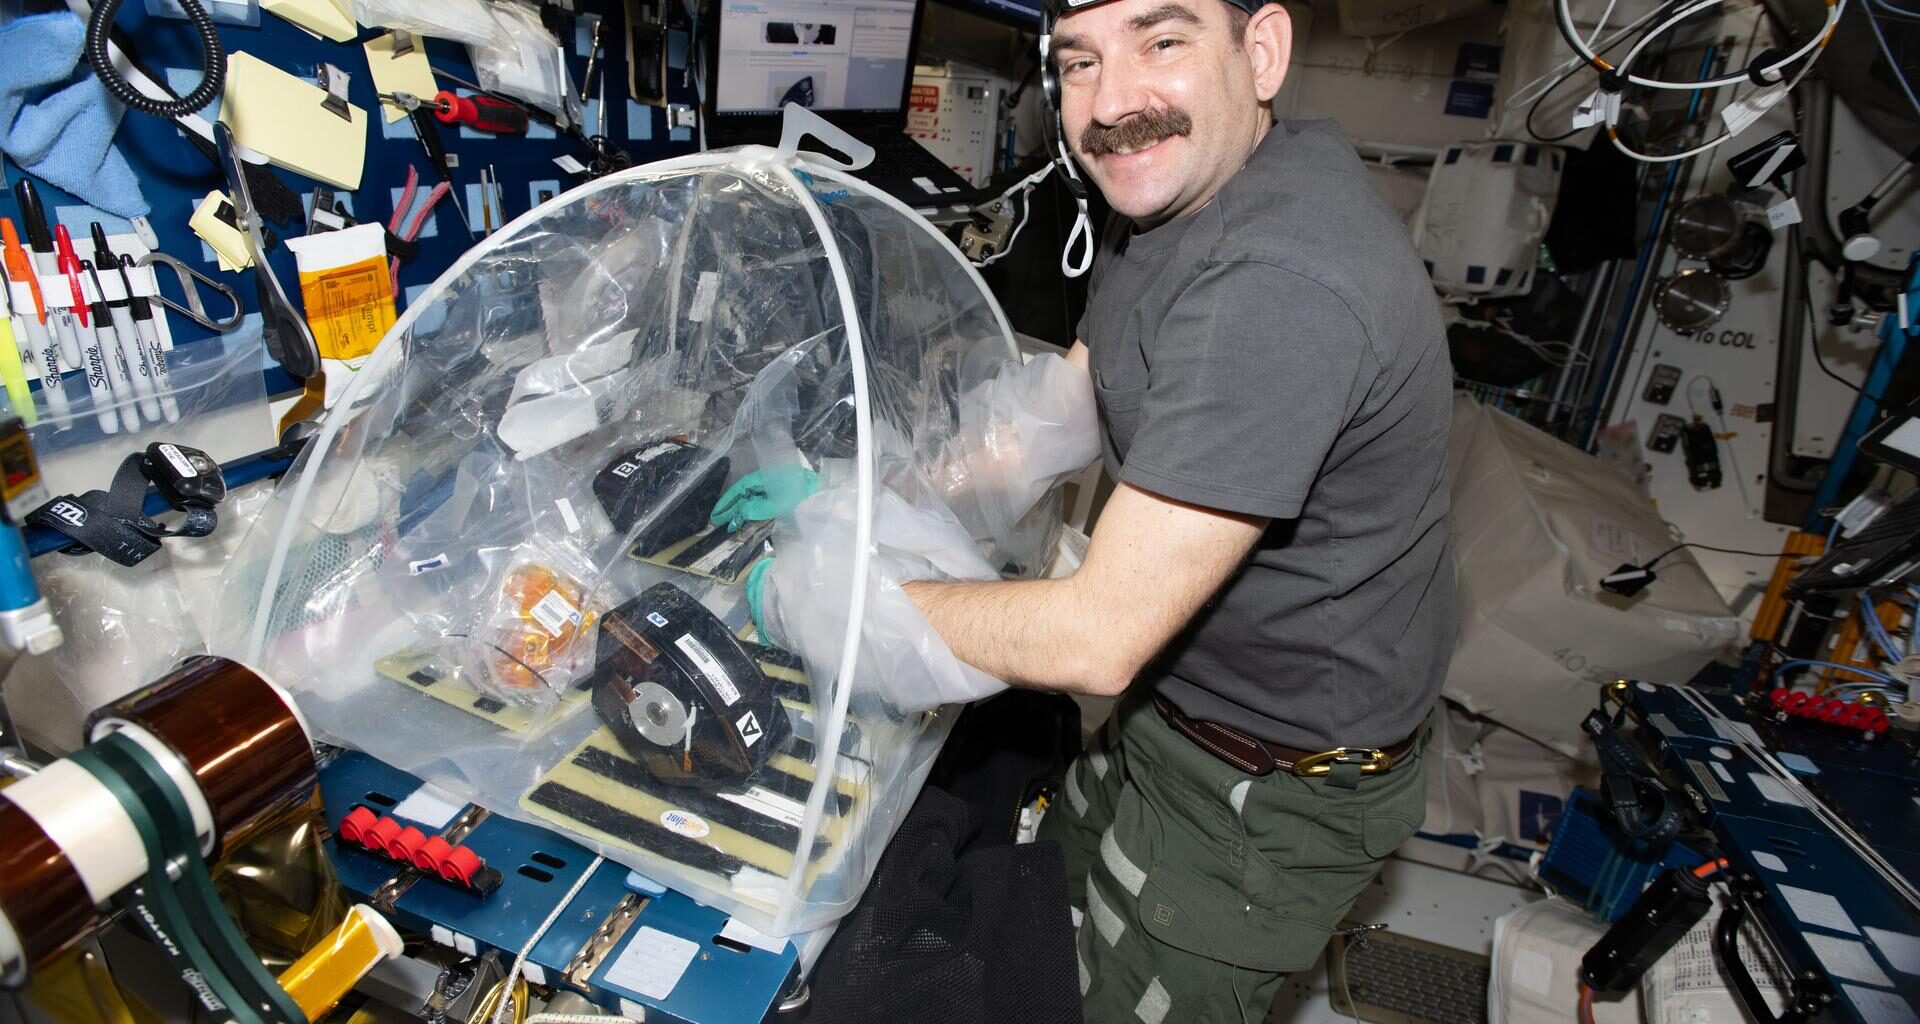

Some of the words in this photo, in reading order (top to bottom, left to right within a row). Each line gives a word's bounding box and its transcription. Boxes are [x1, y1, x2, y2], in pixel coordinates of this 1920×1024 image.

[1720, 331, 1756, 349] COL
[42, 346, 64, 390] Sharpie
[86, 345, 108, 390] Sharpie
[50, 501, 84, 527] ETZL
[742, 714, 760, 737] A
